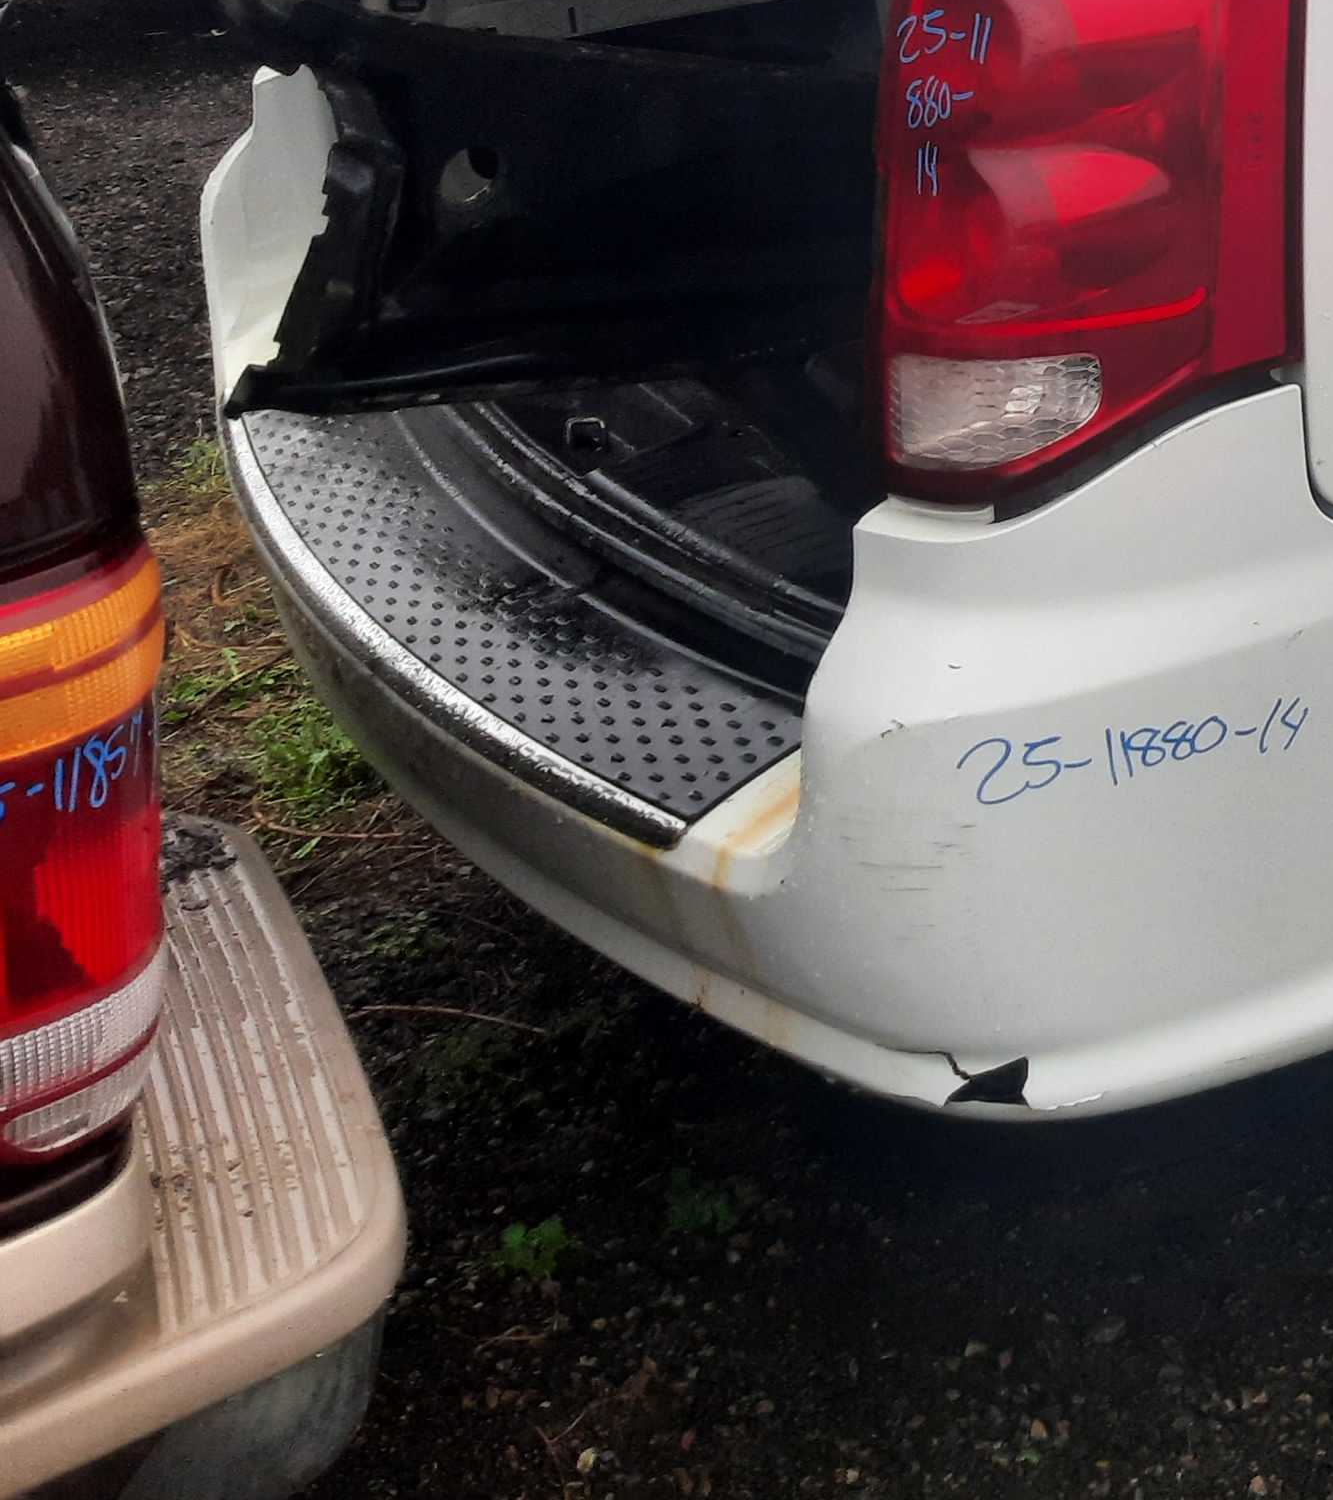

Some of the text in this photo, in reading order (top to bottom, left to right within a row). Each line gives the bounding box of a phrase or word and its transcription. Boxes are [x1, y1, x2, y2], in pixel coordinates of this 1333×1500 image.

[896, 9, 992, 64] 25-11
[906, 75, 975, 129] 880-
[956, 697, 1309, 805] 25-11880-14
